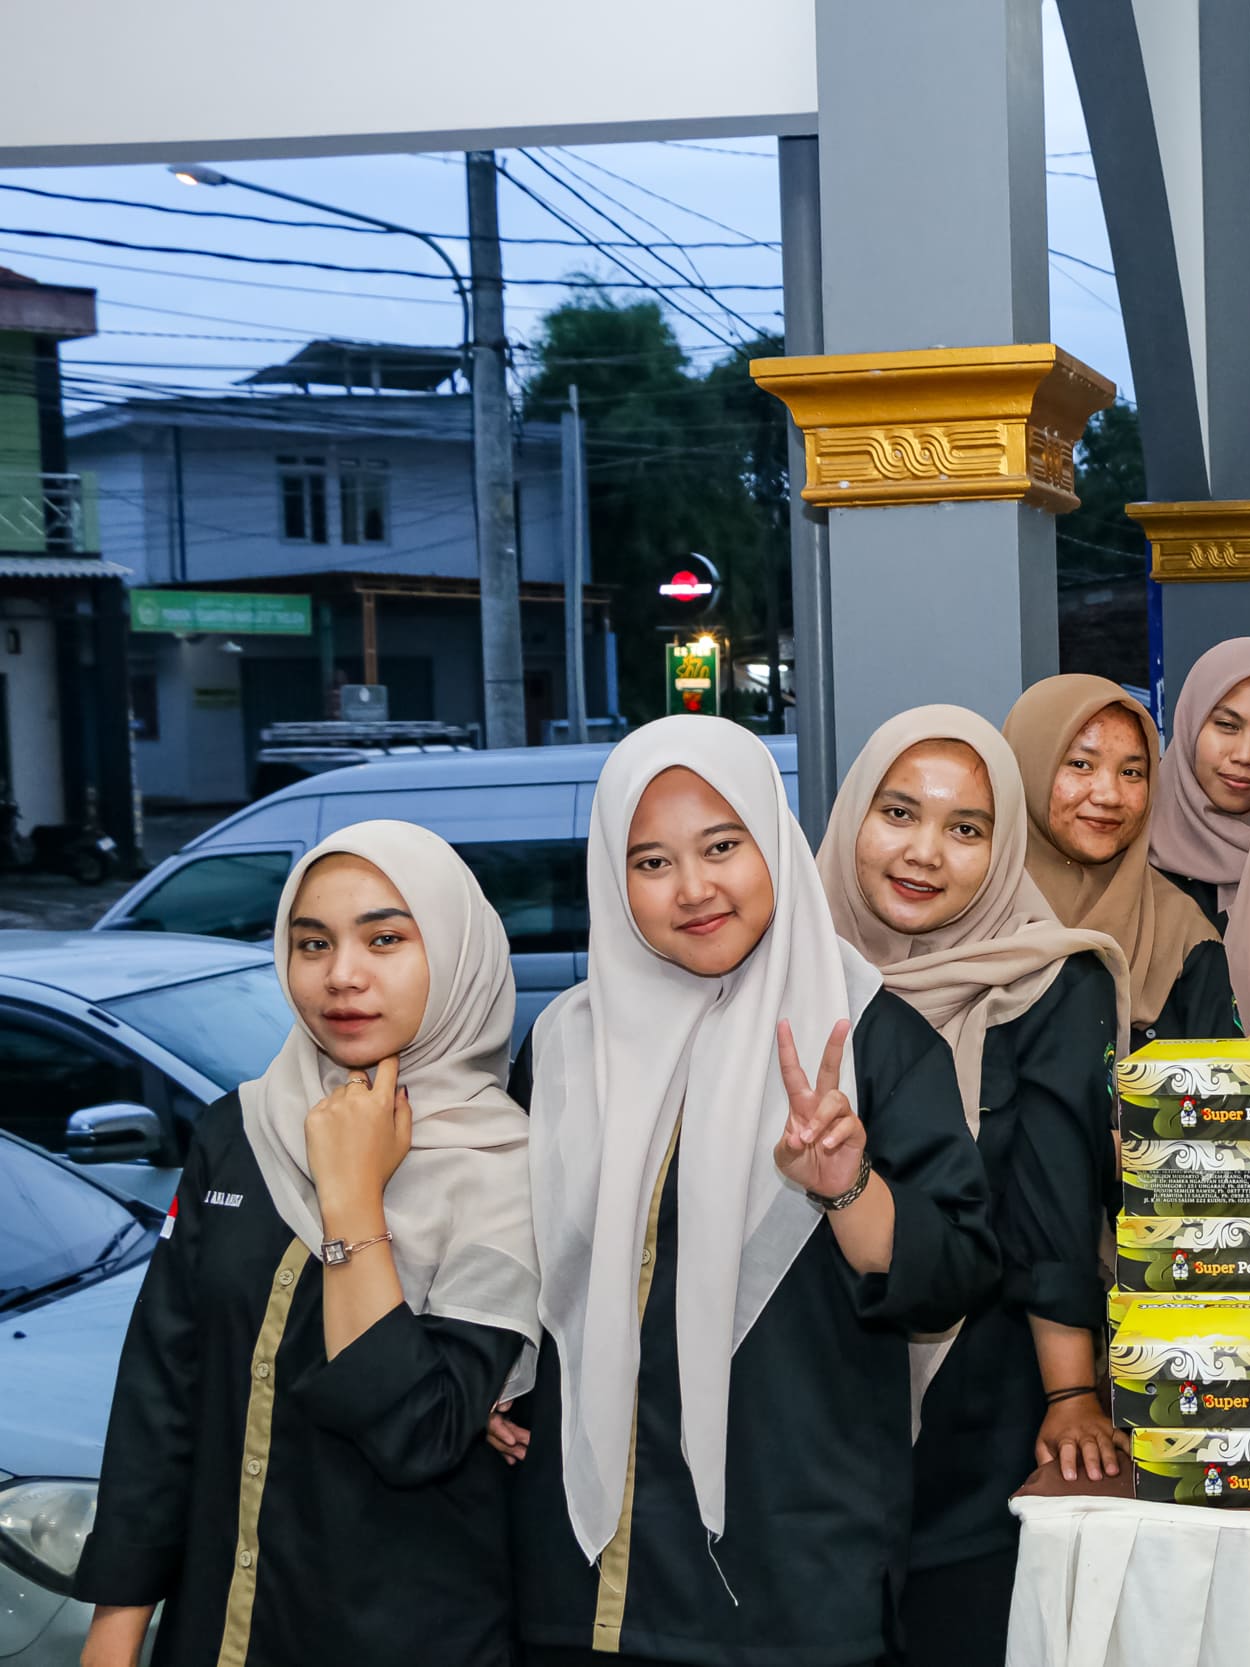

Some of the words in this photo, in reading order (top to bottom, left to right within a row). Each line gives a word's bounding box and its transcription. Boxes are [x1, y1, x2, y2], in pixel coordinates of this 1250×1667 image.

[1203, 1108, 1243, 1123] Super
[1194, 1261, 1235, 1276] Super
[1203, 1395, 1248, 1410] Super
